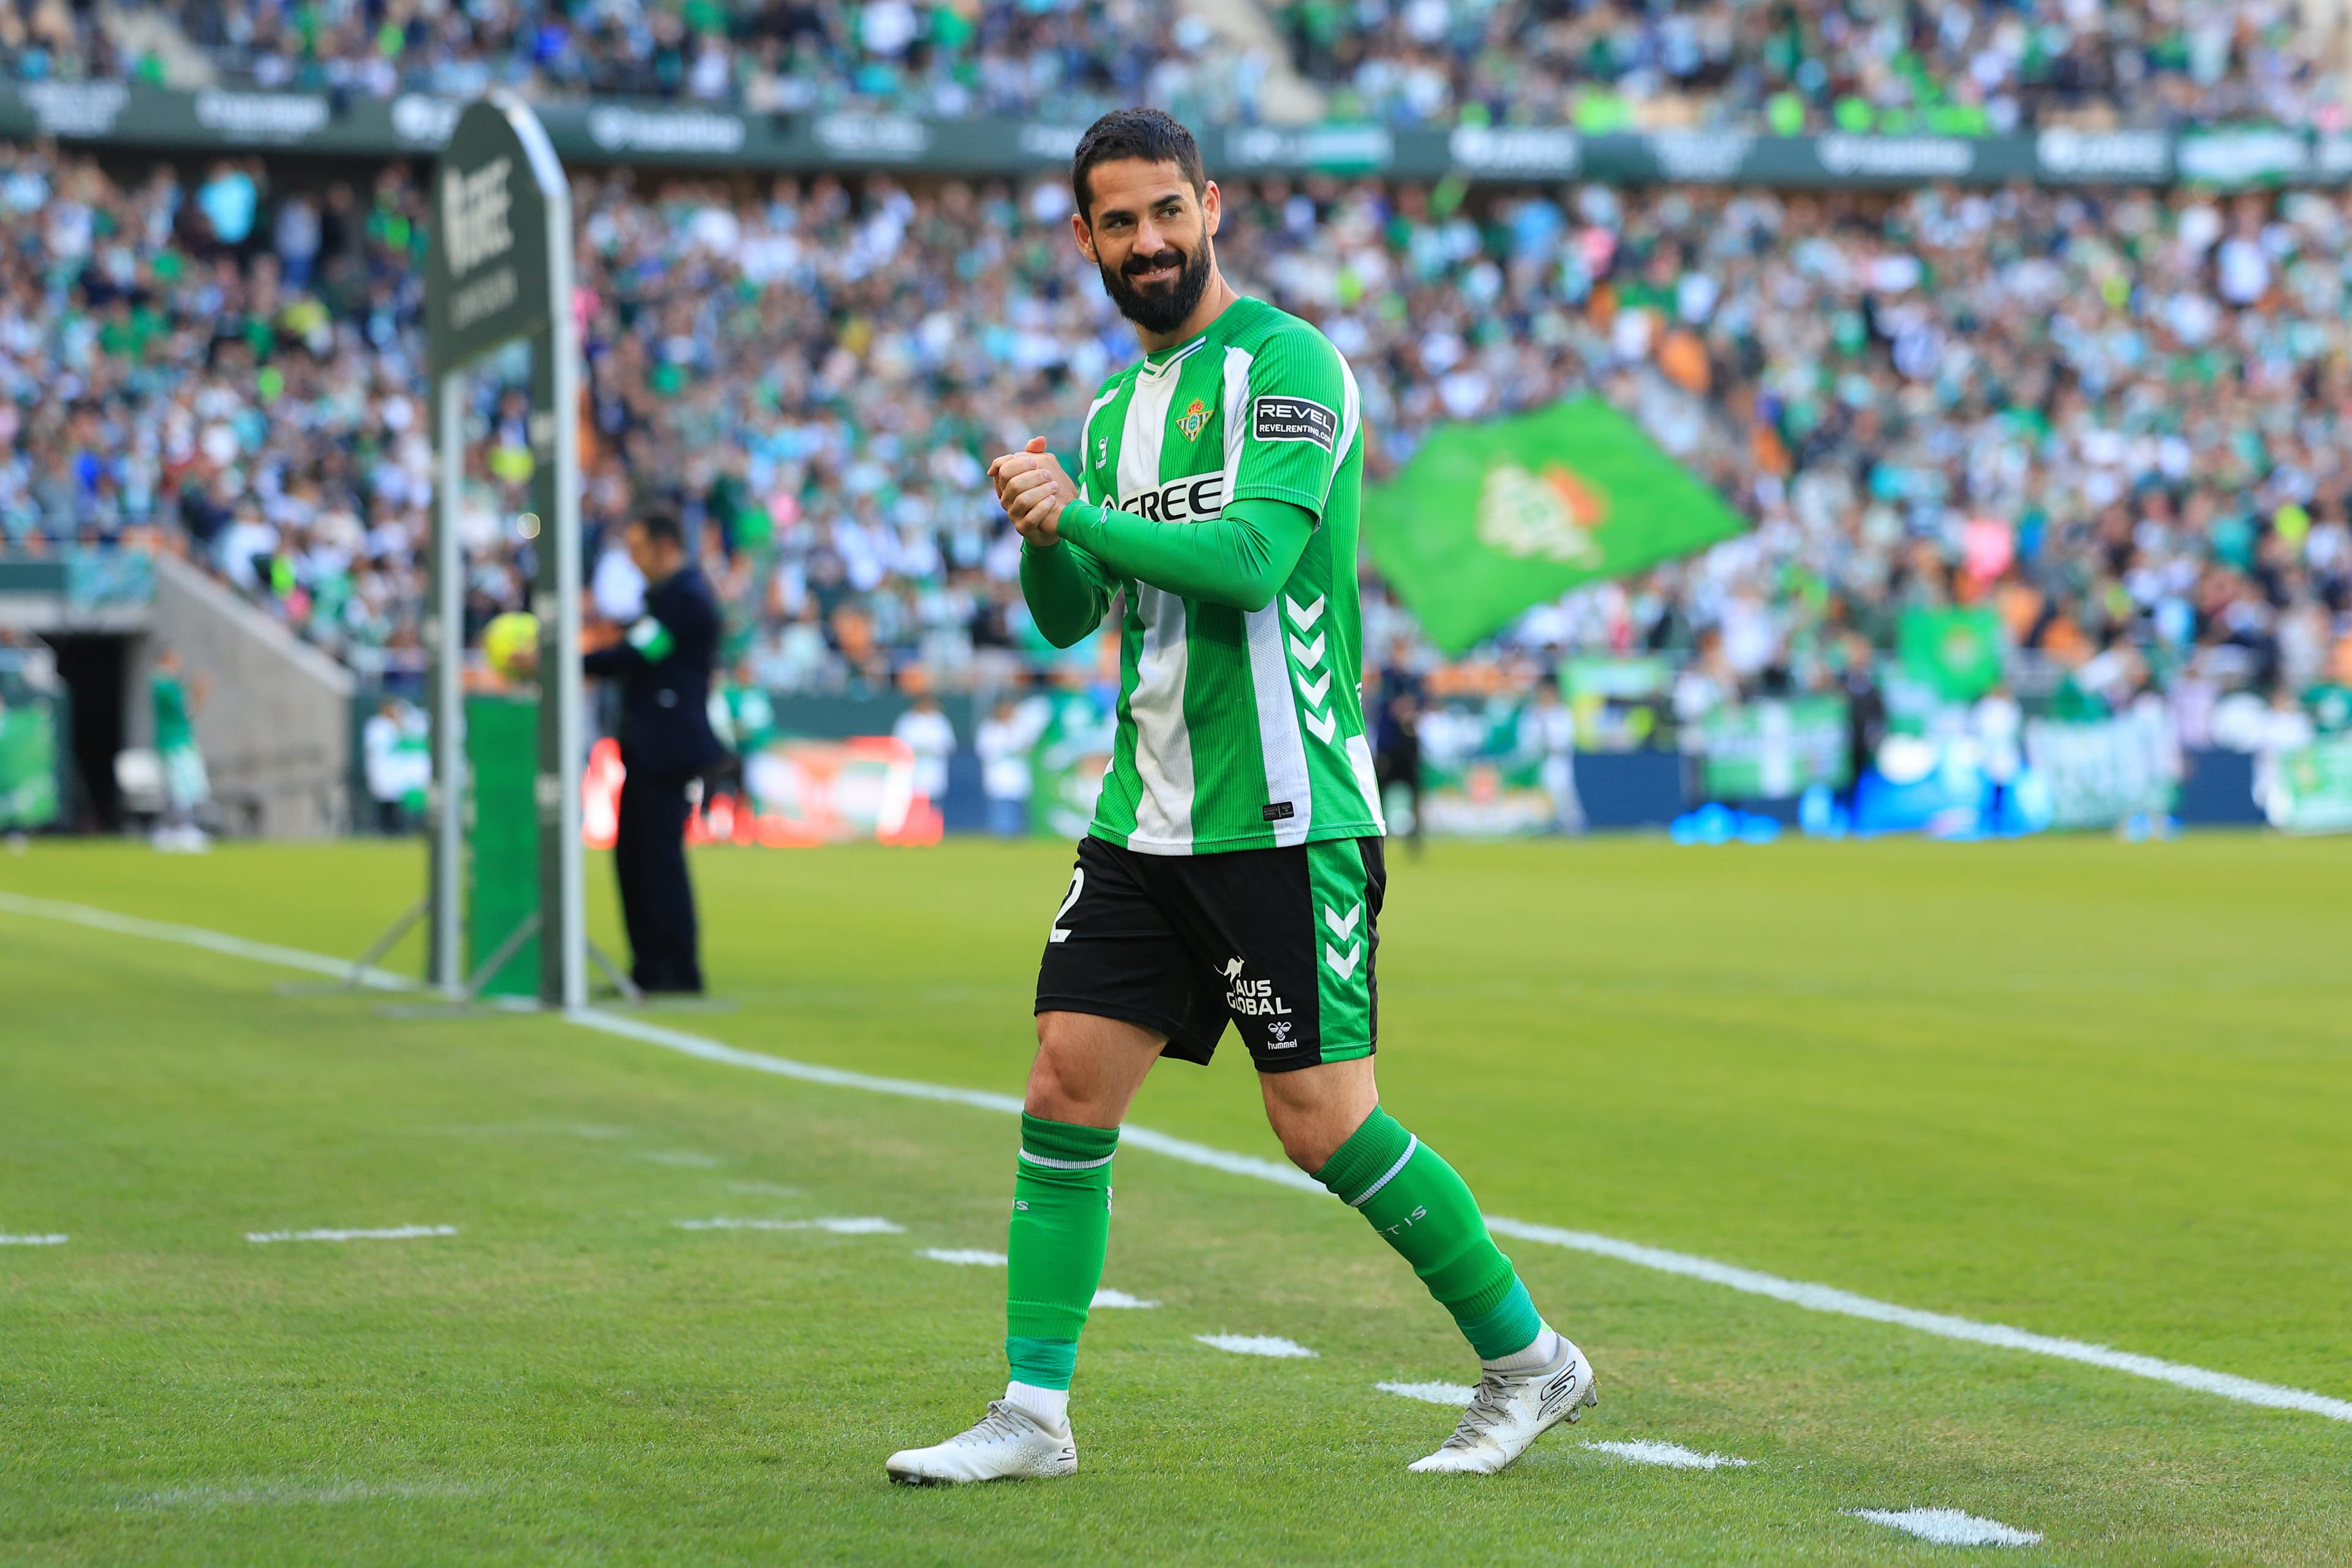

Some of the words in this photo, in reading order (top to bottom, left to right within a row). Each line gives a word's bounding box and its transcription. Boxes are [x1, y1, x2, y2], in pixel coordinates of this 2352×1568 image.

[1260, 405, 1332, 432] REVEL
[1236, 979, 1272, 997] AUS
[1226, 992, 1292, 1016] GLOBAL
[1267, 1038, 1297, 1050] hummel
